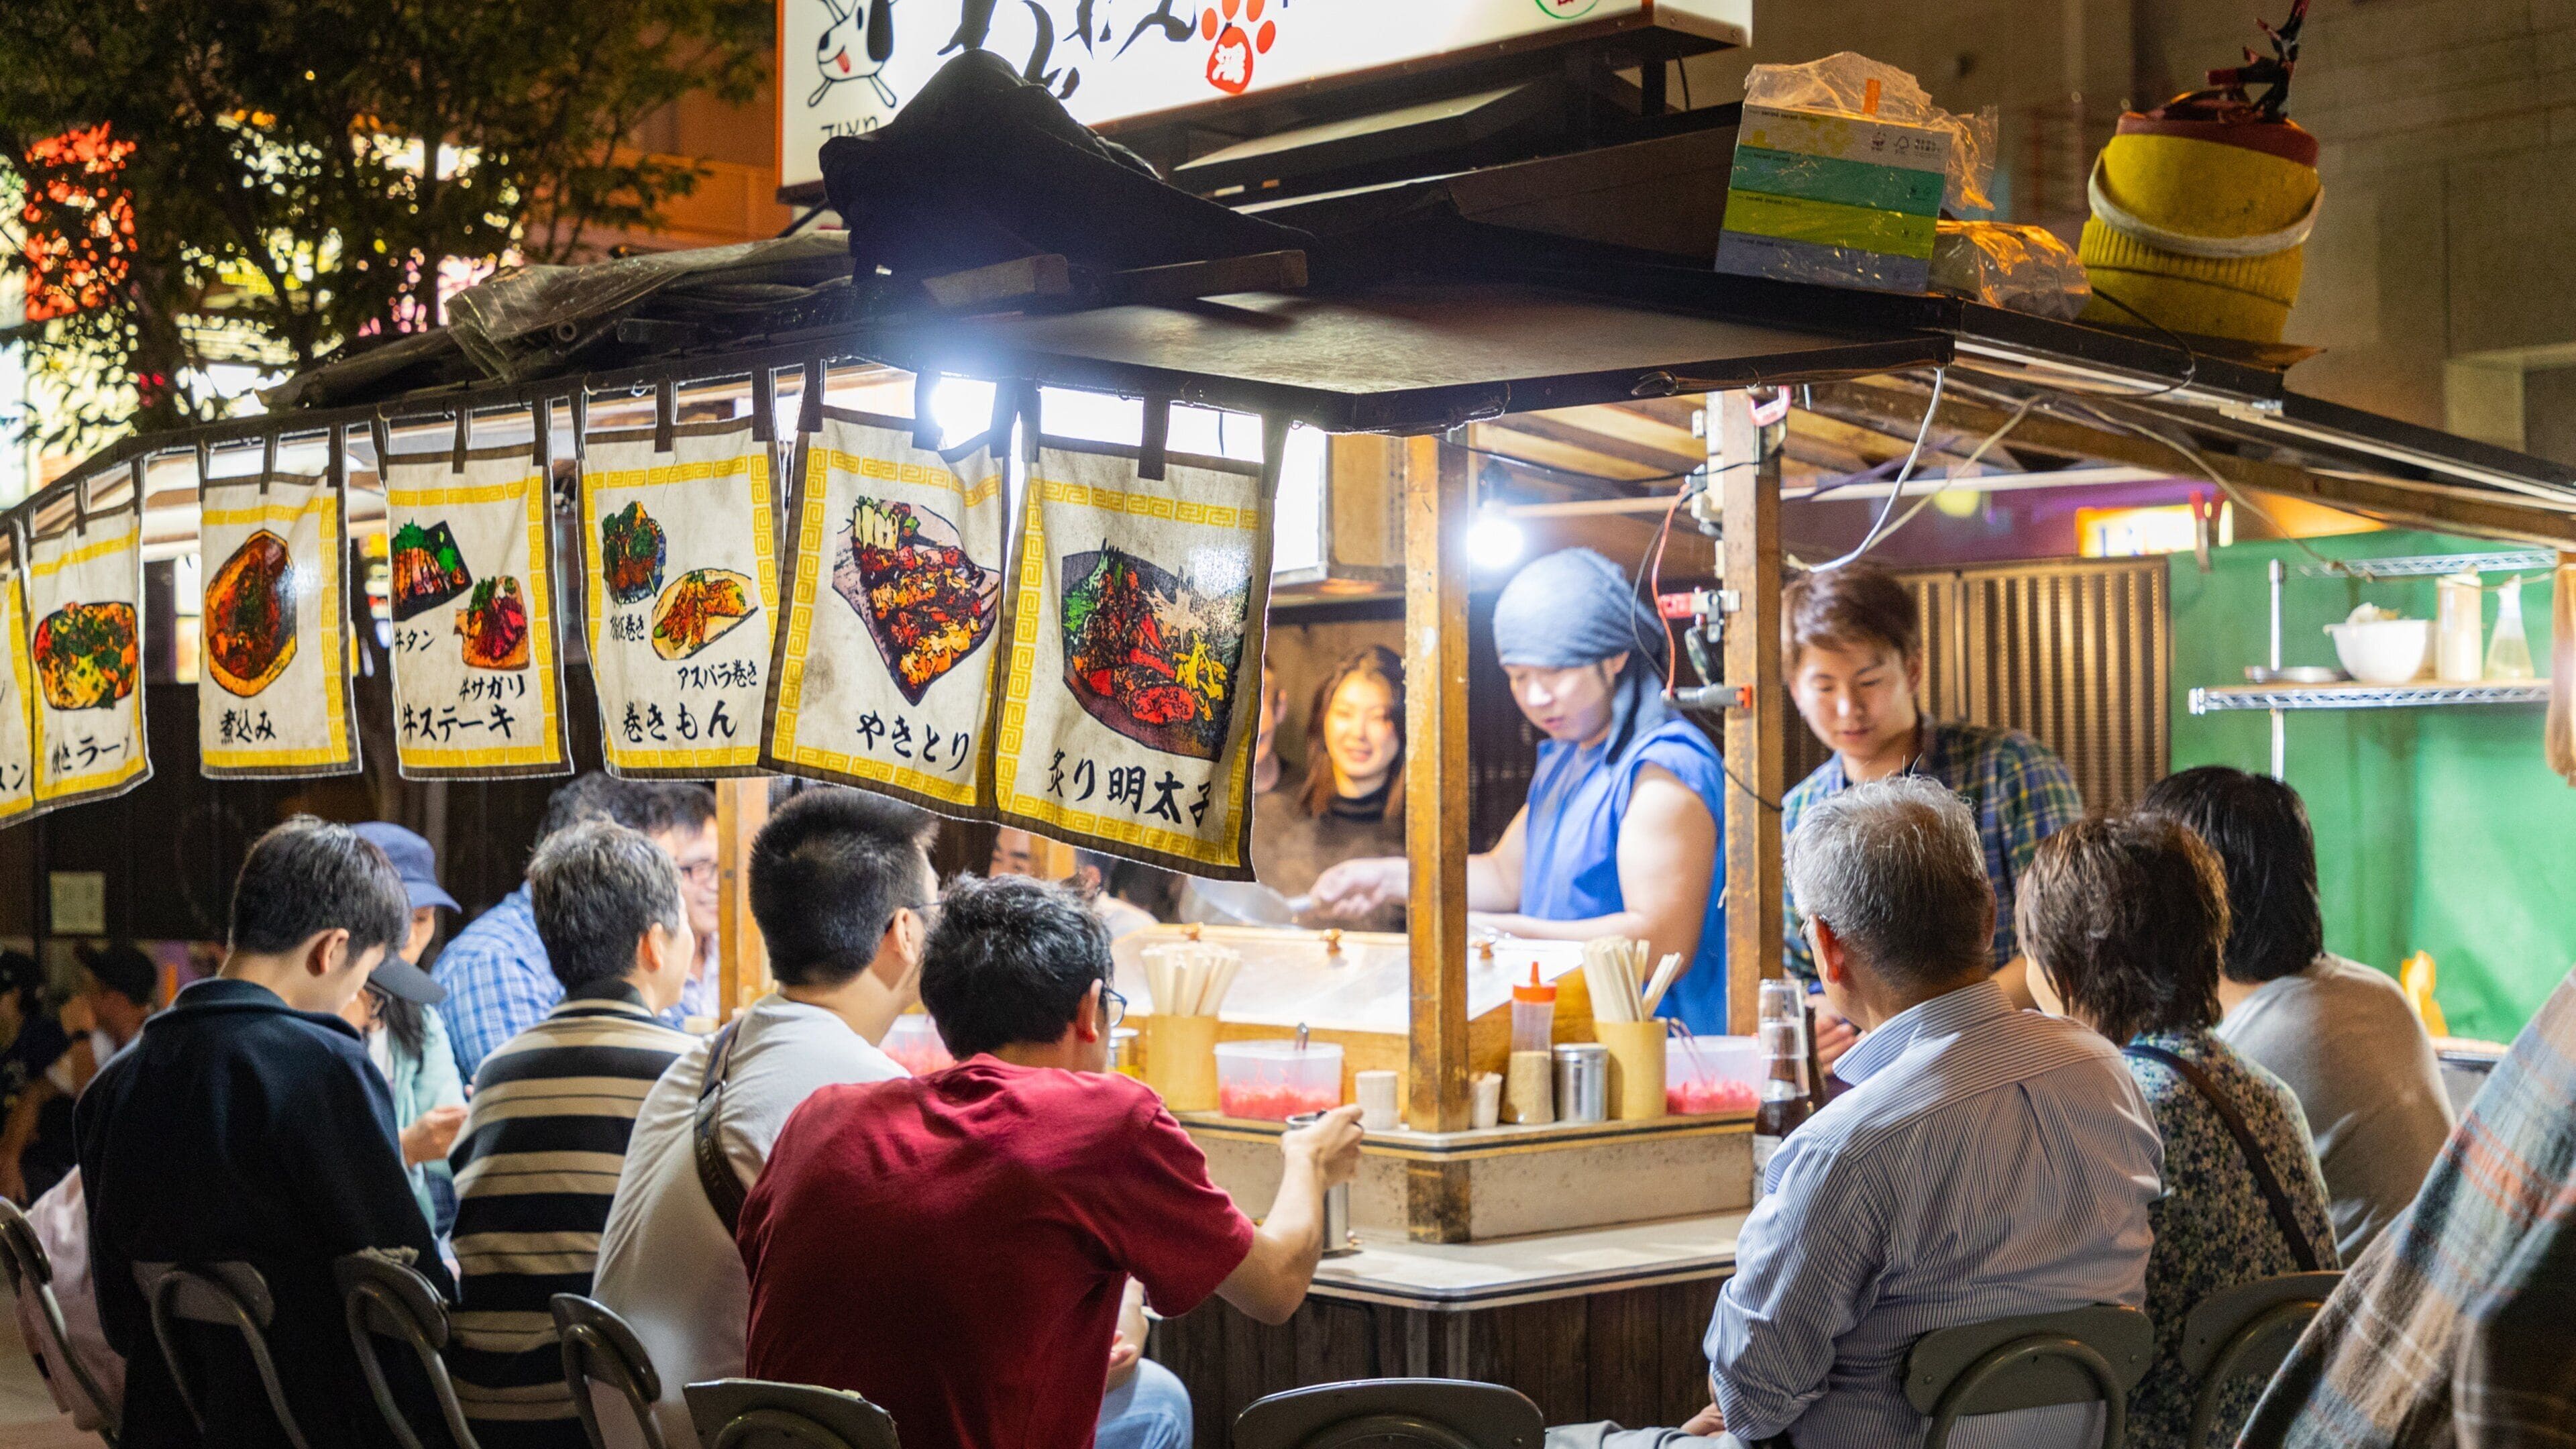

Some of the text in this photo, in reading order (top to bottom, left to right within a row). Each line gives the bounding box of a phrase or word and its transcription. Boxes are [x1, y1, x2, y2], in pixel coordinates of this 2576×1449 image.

[395, 627, 436, 653] 牛タン
[459, 674, 525, 702] 牛サガリ
[677, 659, 757, 691] アスパラ巻き
[219, 708, 276, 745] 煮込み
[404, 702, 515, 743] 牛ステーキ
[623, 698, 738, 743] 巻きもん
[856, 709, 970, 772] やきとり
[1046, 747, 1212, 828] 炙り明太子
